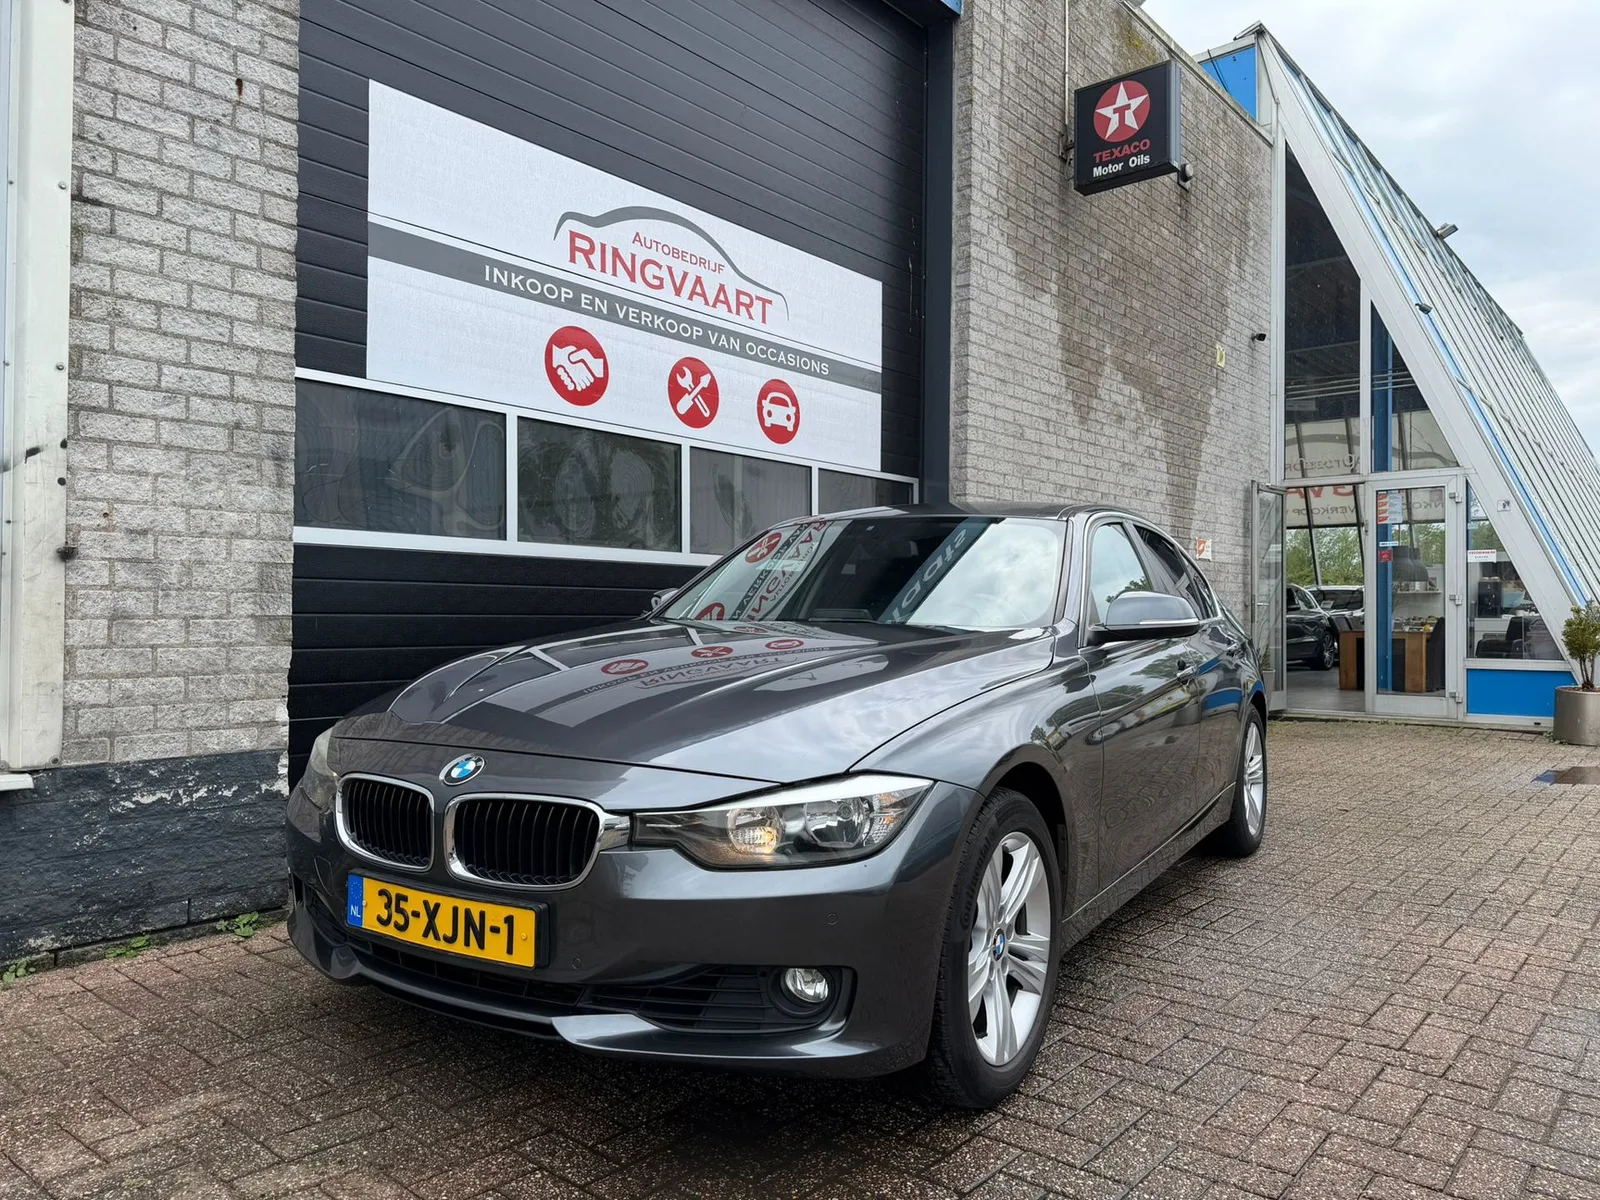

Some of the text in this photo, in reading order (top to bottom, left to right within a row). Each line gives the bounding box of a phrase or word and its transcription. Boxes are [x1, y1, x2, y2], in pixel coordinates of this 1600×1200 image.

[1092, 154, 1151, 178] Motor Oils
[1093, 138, 1151, 164] TEXACO
[632, 231, 725, 275] AUTOBEDRIJF
[568, 230, 773, 325] RINGVAART
[484, 264, 830, 376] INKOOP EN VERKOOP VAN OCCASIONS
[350, 905, 361, 918] NL
[376, 888, 515, 956] 35-XJN-1
